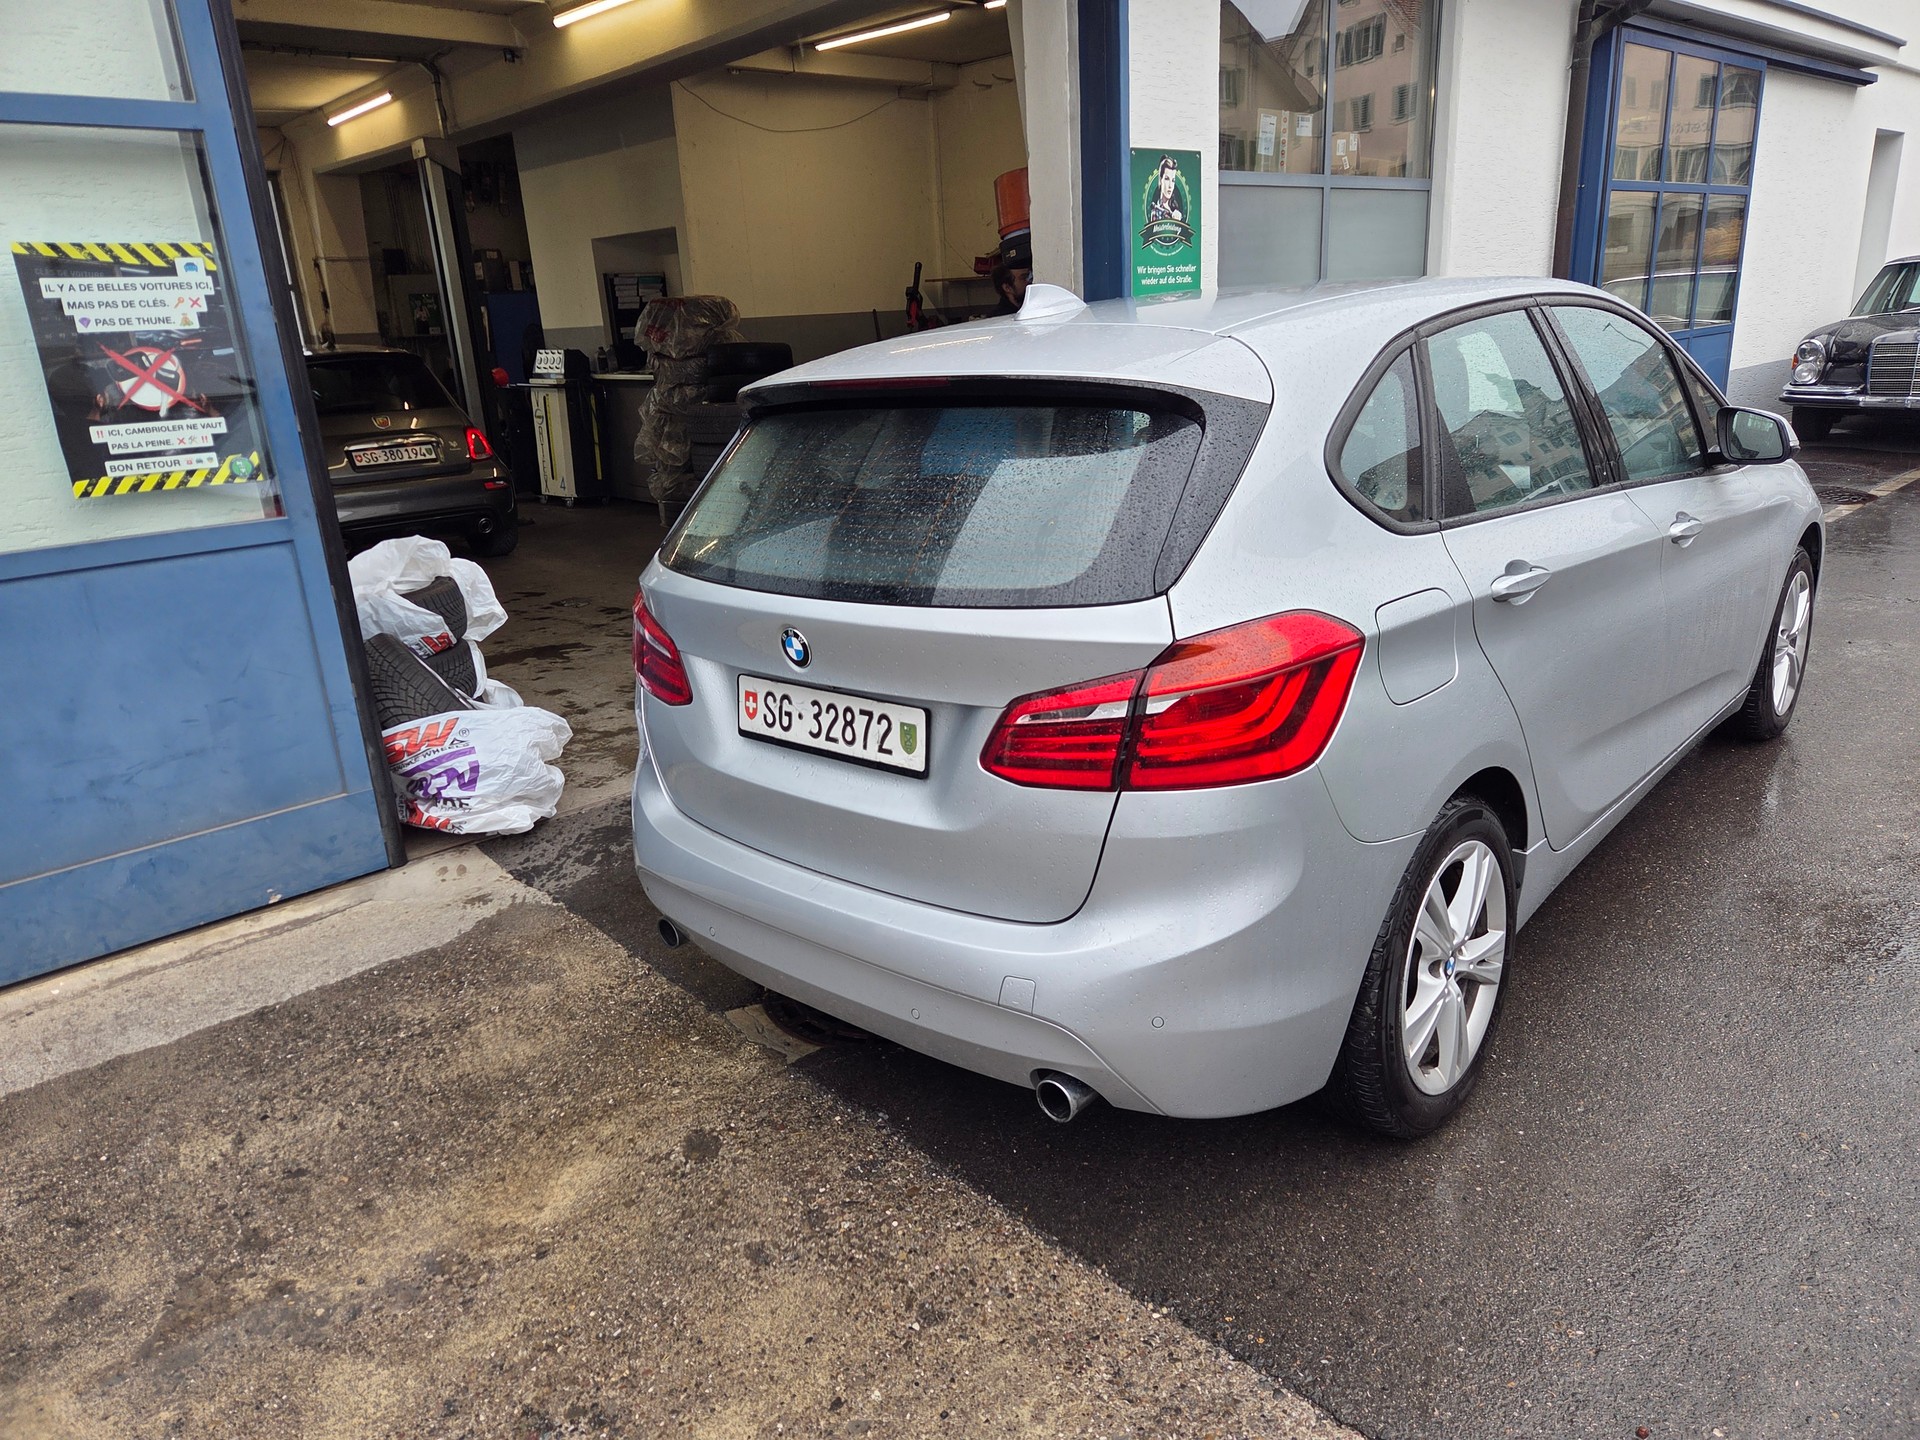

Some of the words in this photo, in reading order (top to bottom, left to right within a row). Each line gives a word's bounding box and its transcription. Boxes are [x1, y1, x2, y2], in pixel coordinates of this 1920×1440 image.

[1137, 265, 1147, 274] Wir
[1148, 265, 1166, 275] bringen
[1175, 264, 1196, 272] schneller
[1141, 276, 1158, 285] wieder
[1159, 275, 1167, 284] auf
[44, 283, 55, 293] IL
[57, 283, 65, 292] Y
[68, 283, 77, 292] A
[79, 283, 94, 292] DE
[97, 283, 137, 292] BELLES
[139, 282, 192, 291] VOITURES
[195, 282, 213, 292] ICI,
[67, 301, 95, 310] MAIS
[98, 300, 119, 309] PAS
[121, 300, 136, 309] DE
[139, 298, 169, 308] CLÉS.
[94, 317, 115, 327] PAS
[118, 317, 134, 326] DE
[136, 316, 176, 326] THUNE.
[107, 428, 124, 438] ICI,
[125, 424, 184, 436] CAMBRIOLER
[187, 423, 199, 431] NE
[200, 421, 223, 430] VAUT
[111, 441, 129, 451] PAS
[131, 441, 143, 449] LA
[145, 438, 175, 448] PEINE.
[109, 462, 134, 472] BON
[136, 459, 181, 471] RETOUR
